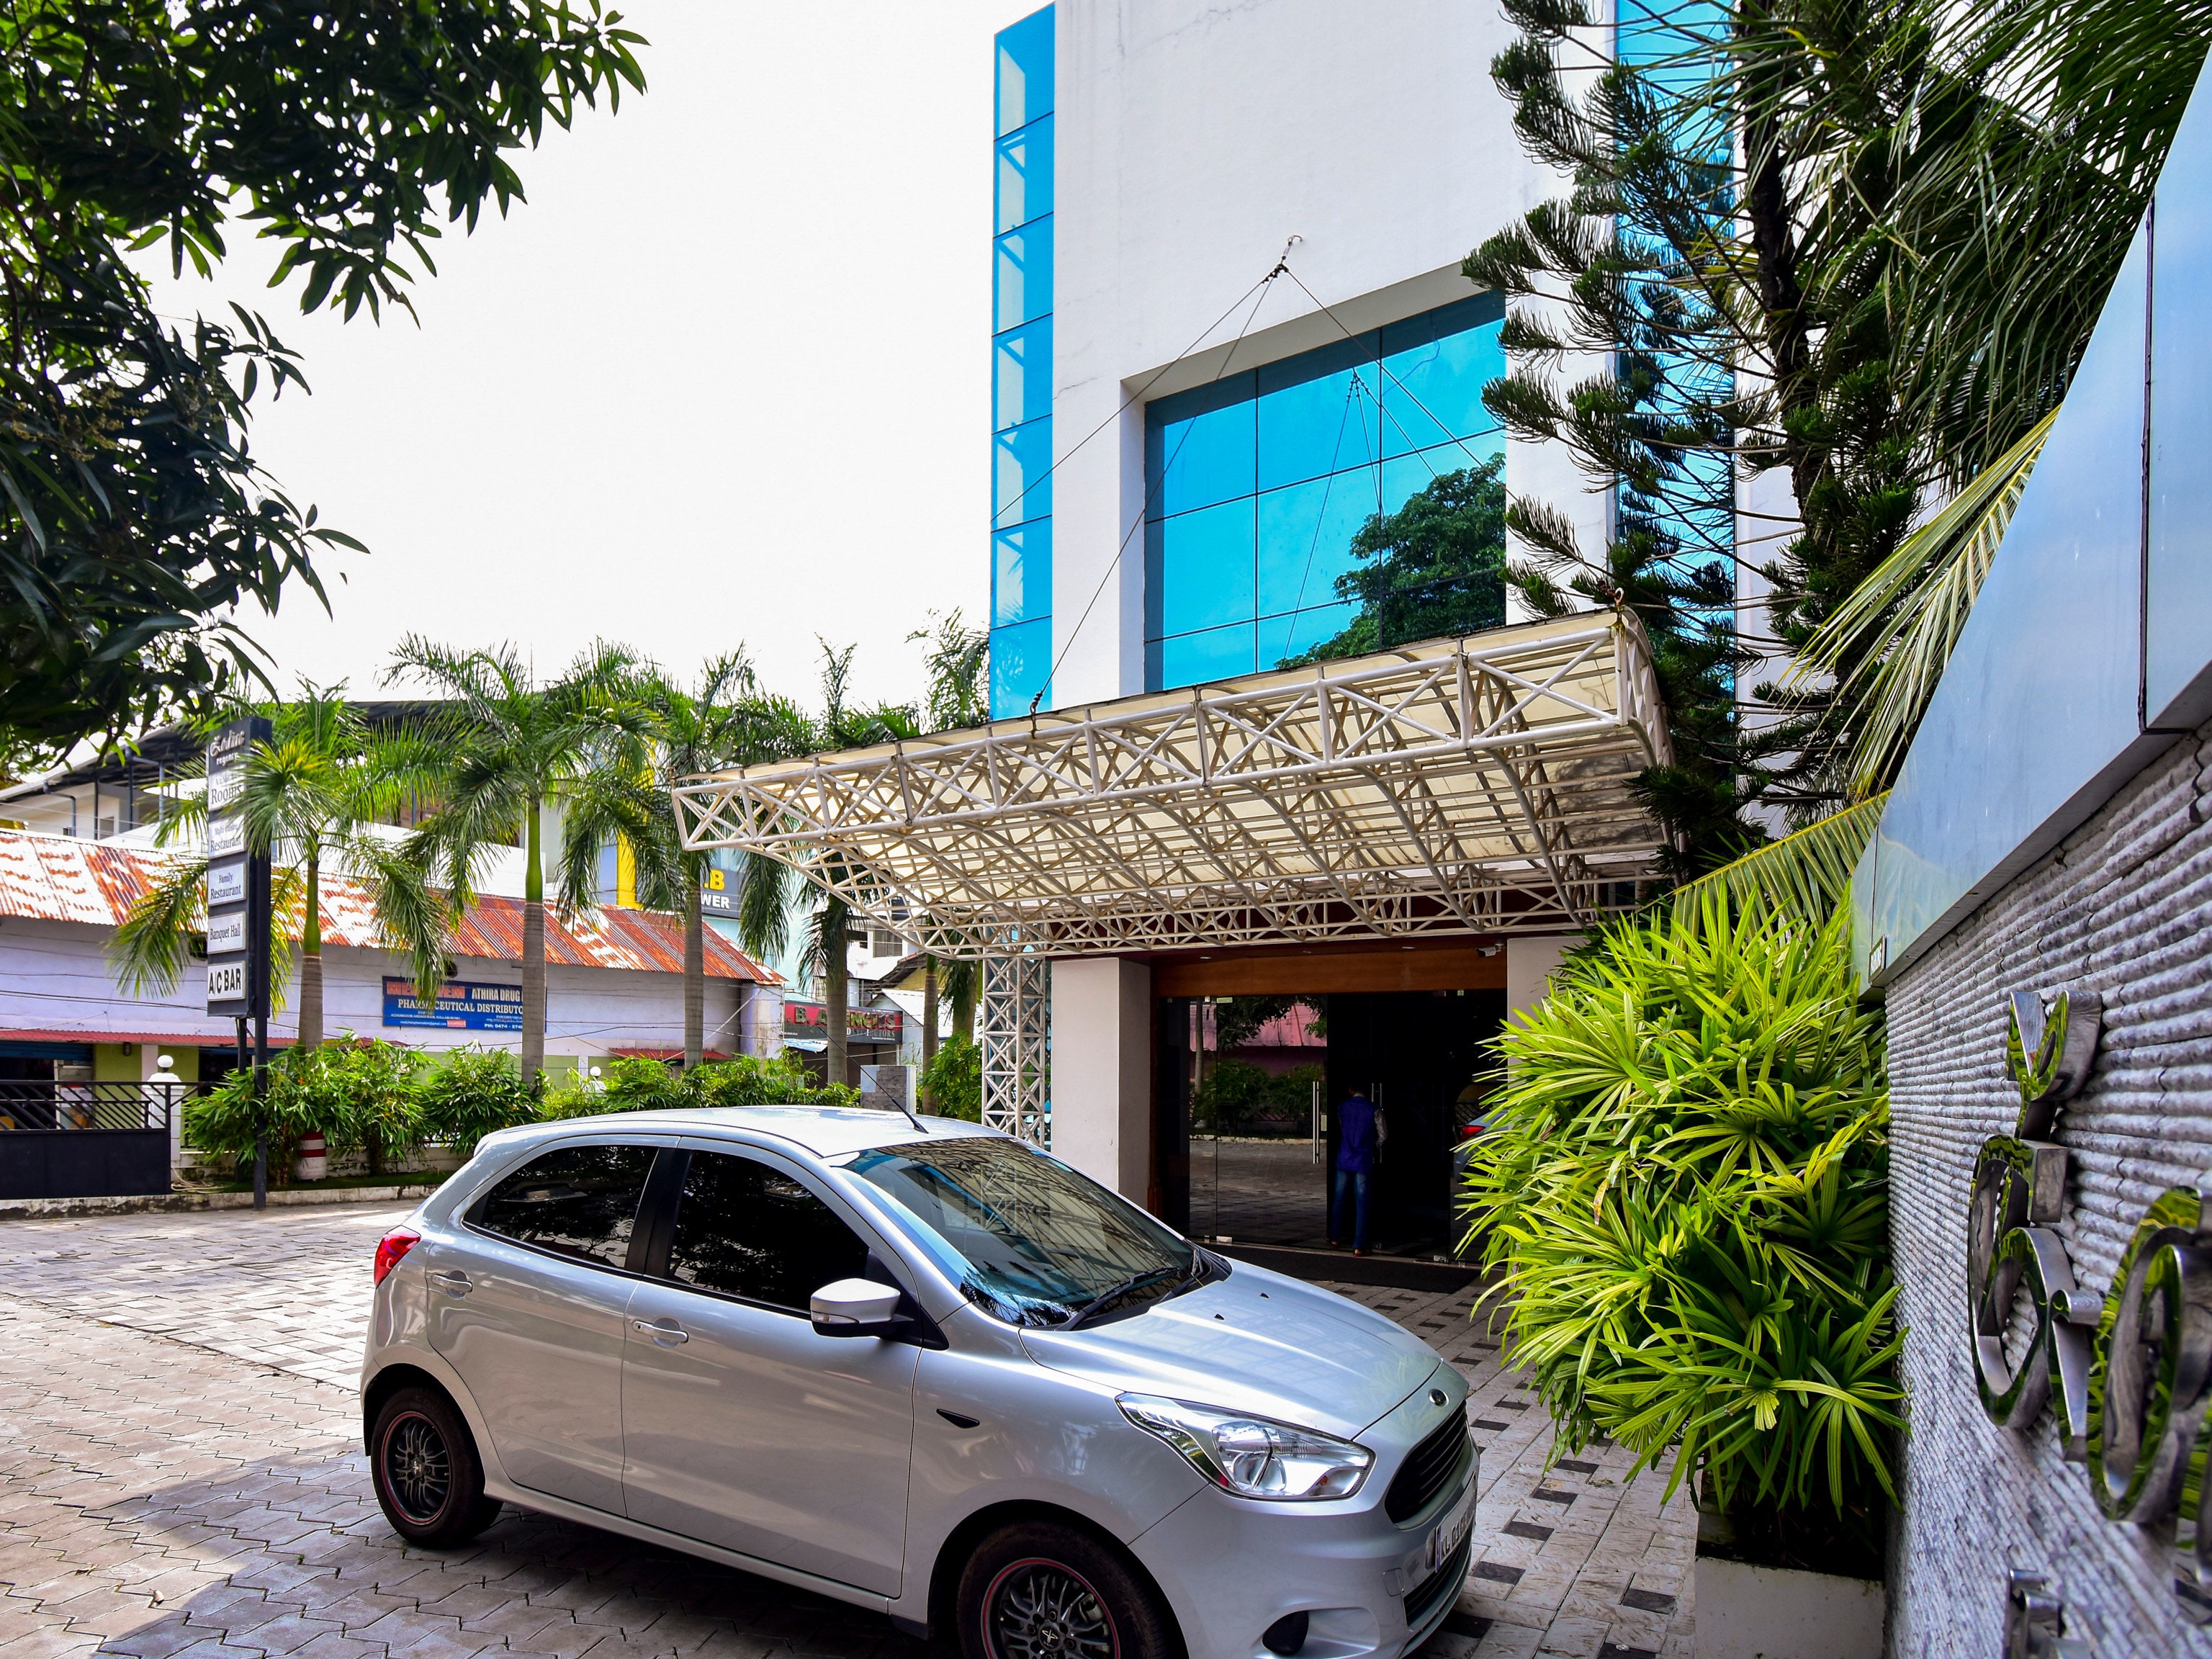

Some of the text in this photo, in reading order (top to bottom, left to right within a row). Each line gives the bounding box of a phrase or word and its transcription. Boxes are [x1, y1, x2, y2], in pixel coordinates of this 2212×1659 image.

[210, 837, 242, 853] Restaurant
[219, 873, 234, 884] Family
[210, 885, 242, 900] Restaurant
[701, 894, 730, 909] WER
[210, 923, 241, 943] Banquet Hall
[208, 968, 242, 996] A/C BAR
[472, 987, 499, 1001] ATHIRA
[500, 989, 521, 1002] DRUG
[477, 1003, 523, 1015] DISTRIBUTO
